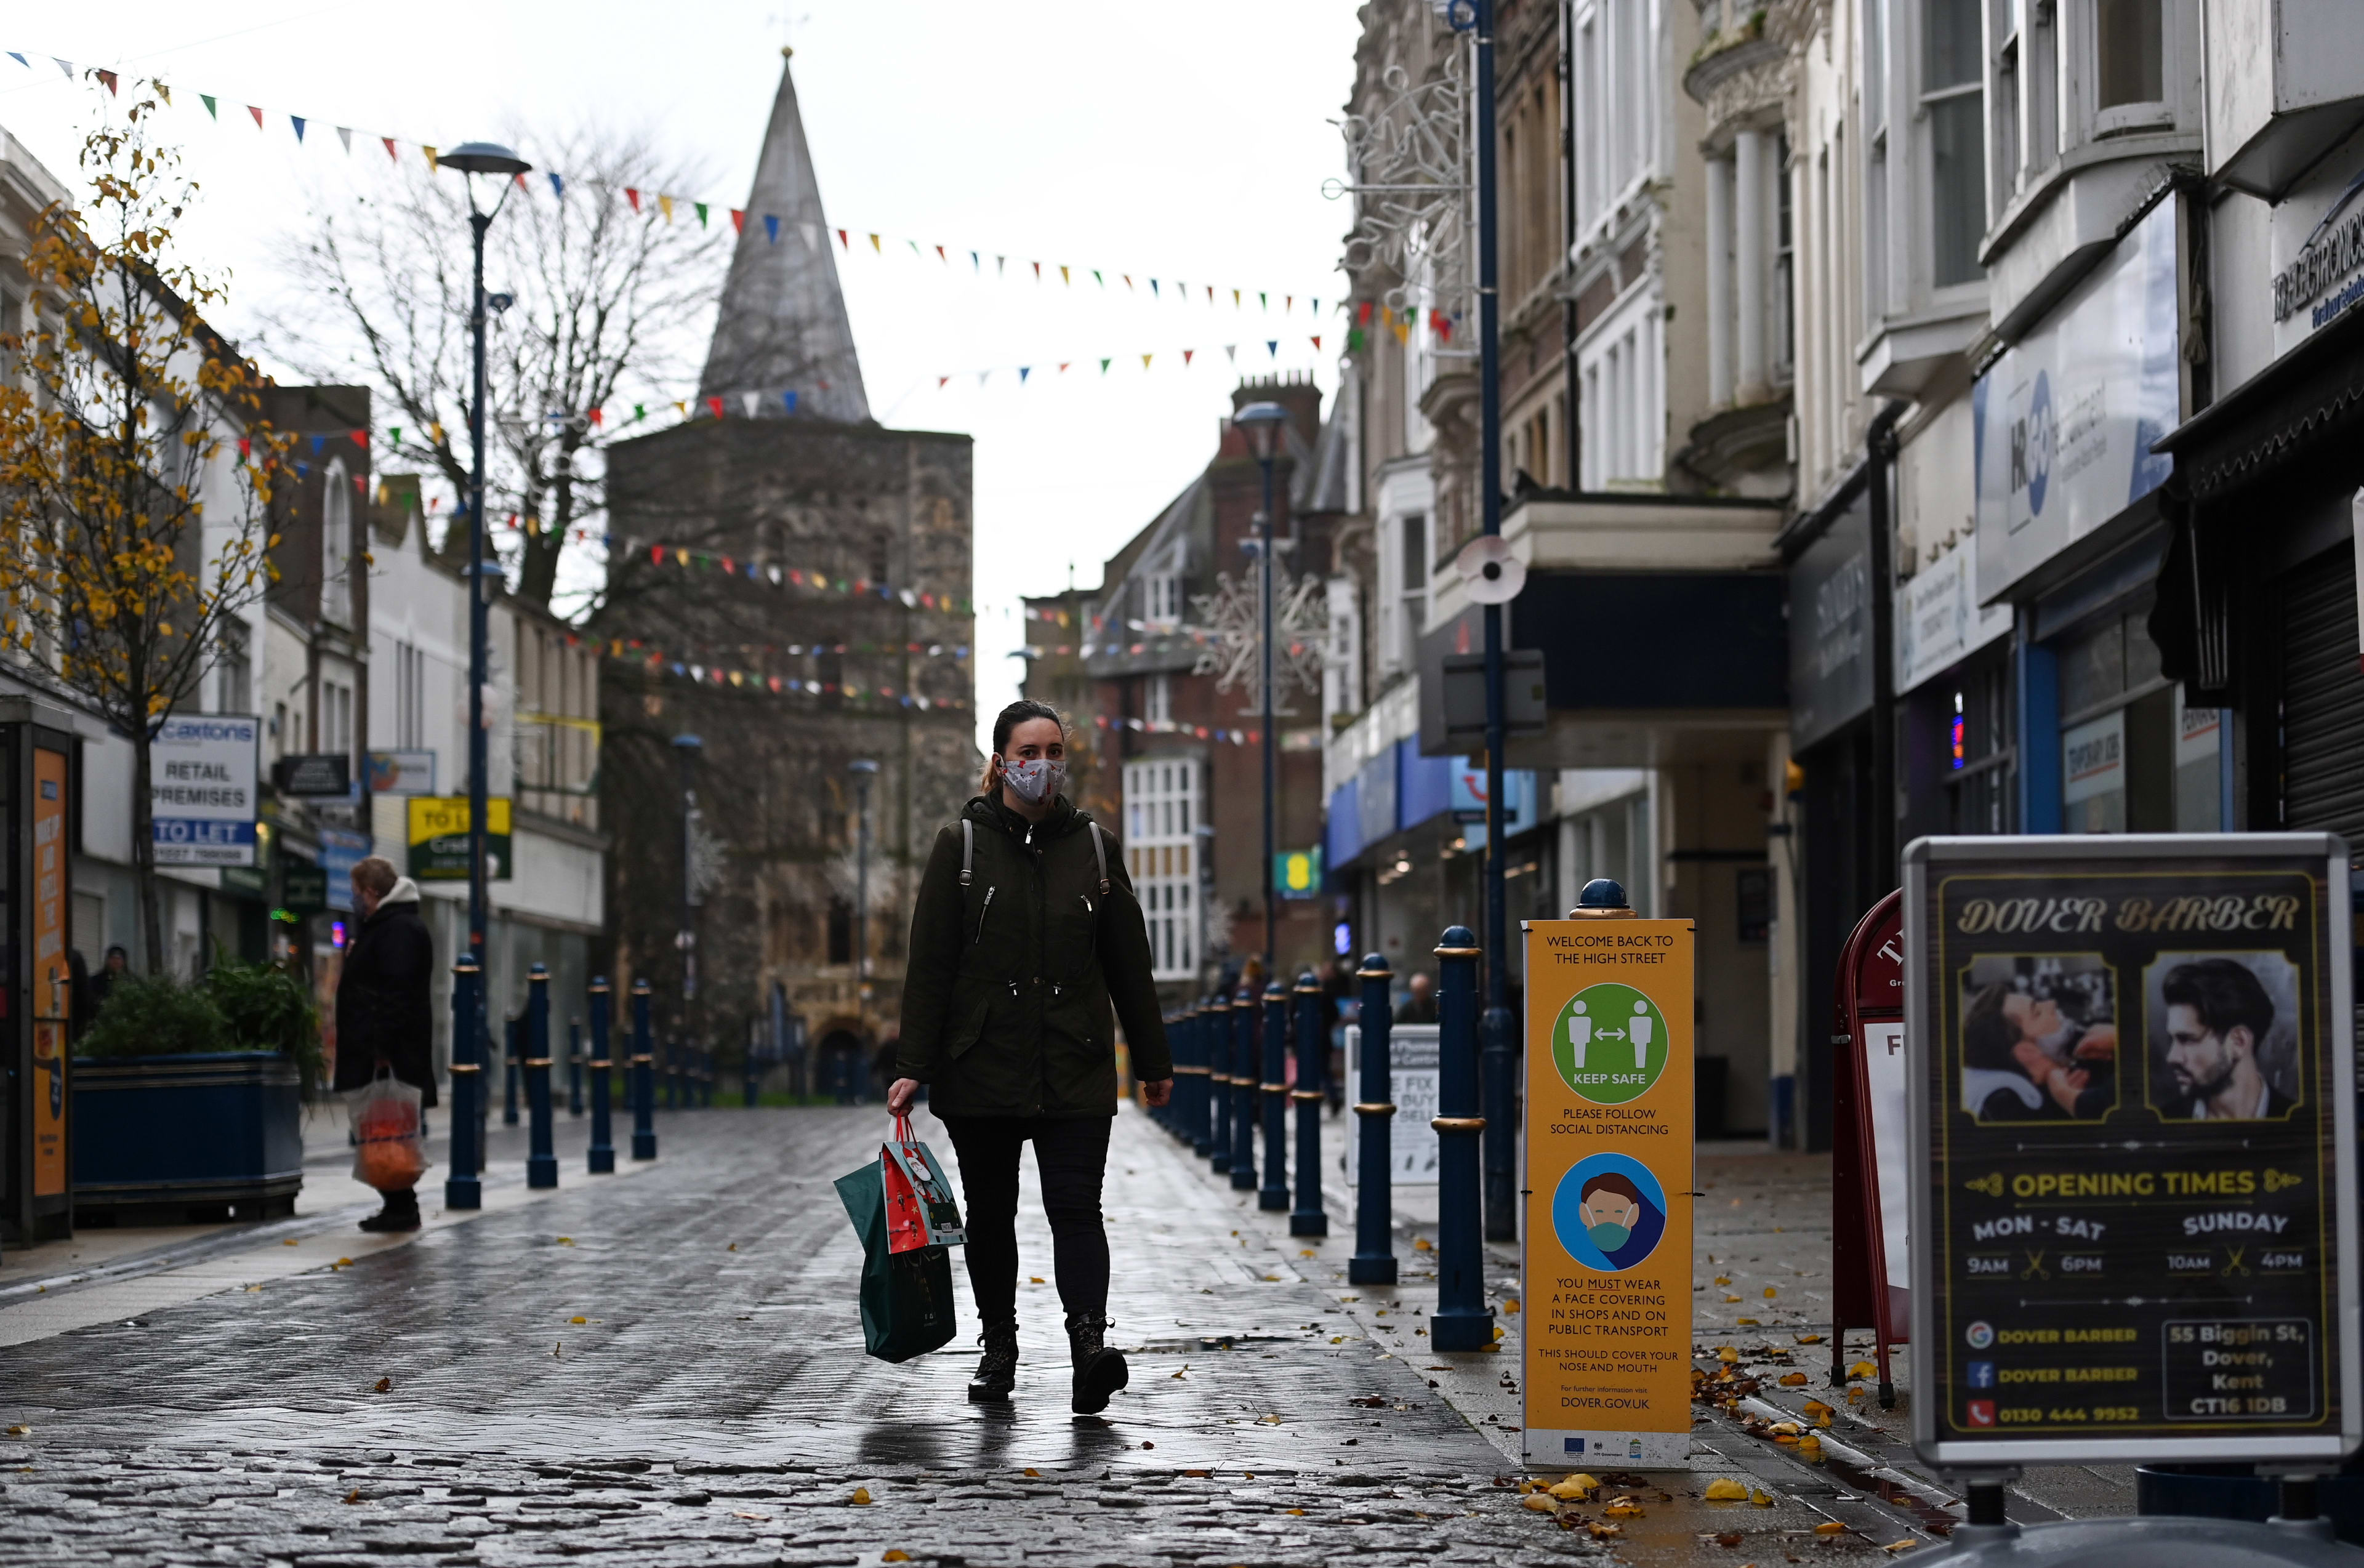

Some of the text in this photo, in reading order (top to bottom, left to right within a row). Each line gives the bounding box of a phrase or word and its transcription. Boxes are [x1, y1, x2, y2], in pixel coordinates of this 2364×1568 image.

[2011, 416, 2027, 494] HR
[165, 760, 231, 782] RETAIL
[155, 820, 238, 844] TO LET
[1956, 895, 2301, 934] DOVER BARBER
[1546, 936, 1673, 947] WELCOME BACK TO
[1554, 952, 1666, 964] THE HIGH STREET
[1405, 1078, 1433, 1091] FIX
[1574, 1074, 1646, 1084] KEEP SAFE
[1401, 1094, 1434, 1107] BUY
[1564, 1109, 1656, 1119] PLEASE FOLLOW
[1551, 1124, 1668, 1135] SOCIAL DISTANCING
[2012, 1170, 2256, 1197] OPENING TIMES
[1972, 1215, 2033, 1241] MON
[2056, 1216, 2107, 1241] SAT
[2182, 1212, 2288, 1236] SUNDAY
[1967, 1256, 2102, 1273] 9AM 6PM
[2167, 1252, 2302, 1269] 10AM 4PM
[1556, 1278, 1661, 1290] YOU MUST WEAR
[1552, 1293, 1665, 1306] A FACE COVERING
[1551, 1309, 1665, 1321] IN SHOPS AND ON
[1549, 1324, 1668, 1337] PUBLIC TRANSPORT
[1998, 1330, 2060, 1343] DOVER
[2064, 1329, 2137, 1342] BARBER
[2169, 1324, 2305, 1346] 55 Biggin St,
[1538, 1349, 1679, 1361] THIS SHOULD COVER YOUR
[2202, 1350, 2274, 1369] Dover,
[1559, 1362, 1657, 1373] NOSE AND MOUTH
[1998, 1369, 2060, 1383] DOVER
[2065, 1367, 2138, 1381] BARBER
[2212, 1373, 2264, 1390] Kent
[1561, 1397, 1649, 1409] DOVER.GOV.UK
[2190, 1396, 2286, 1414] CT16 1DB
[2000, 1407, 2139, 1422] 0130 444 9952
